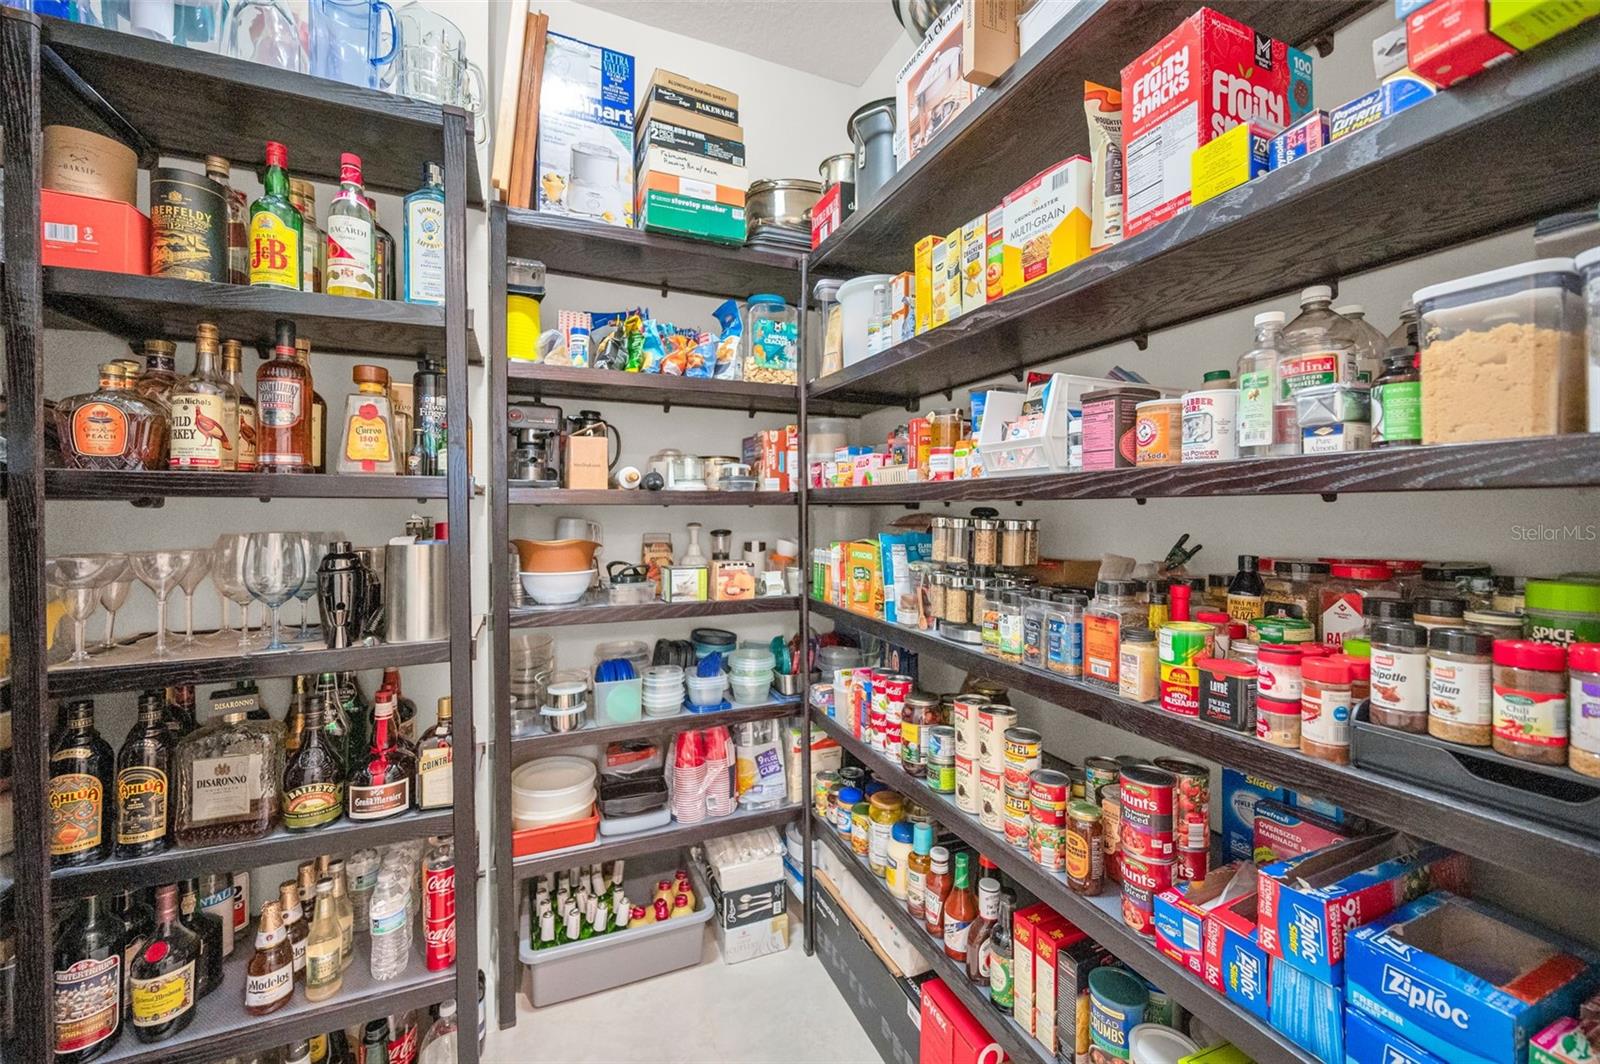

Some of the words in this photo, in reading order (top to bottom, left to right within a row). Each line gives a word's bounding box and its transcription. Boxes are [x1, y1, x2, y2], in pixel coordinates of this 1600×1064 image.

[604, 50, 628, 68] EXTRA
[1294, 56, 1312, 75] 100
[696, 102, 735, 118] BAKEWARE
[650, 128, 659, 139] 2
[1010, 205, 1066, 240] MULTI-GRAIN
[250, 238, 288, 270] J&B
[1532, 626, 1576, 644] SPICE
[1172, 692, 1188, 701] HOT
[1432, 681, 1460, 696] Cajun
[214, 698, 254, 711] DISARONNO
[1164, 696, 1198, 709] MUSTARD
[1506, 704, 1529, 714] Chili
[1500, 710, 1538, 724] Powder
[196, 774, 246, 790] DISARONNO
[1244, 775, 1277, 792] Slider
[288, 784, 336, 800] BAILEYS
[1124, 810, 1149, 826] Diced
[1258, 820, 1302, 842] OVERSIZED
[1258, 829, 1298, 848] MARINADE
[1124, 886, 1148, 902] Diced
[1297, 908, 1320, 964] Ziploc
[1238, 950, 1259, 1000] Ziploc
[1352, 990, 1404, 1026] FREEZER
[1388, 969, 1469, 1030] Ziploc
[1092, 1007, 1119, 1030] BREAD
